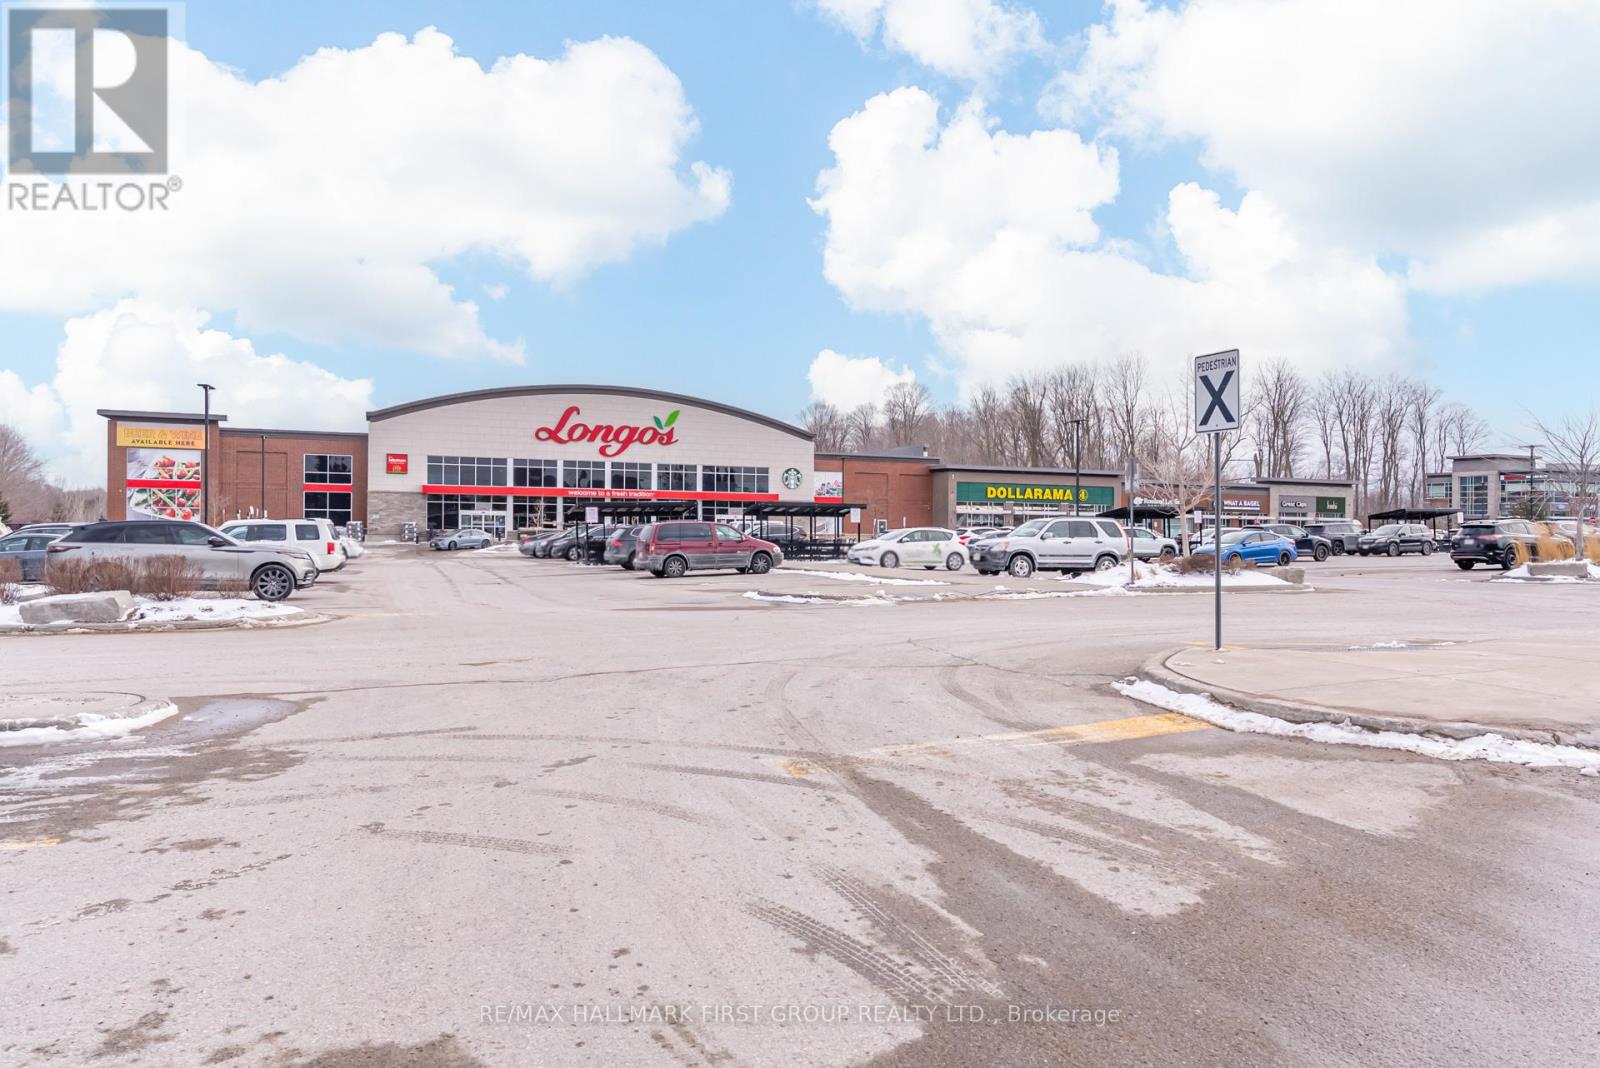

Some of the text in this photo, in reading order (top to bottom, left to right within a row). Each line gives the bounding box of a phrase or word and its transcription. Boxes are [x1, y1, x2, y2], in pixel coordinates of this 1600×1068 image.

[1197, 356, 1237, 372] PEDESTRIAN
[1199, 370, 1236, 426] X
[986, 486, 1073, 501] DOLLARAMA
